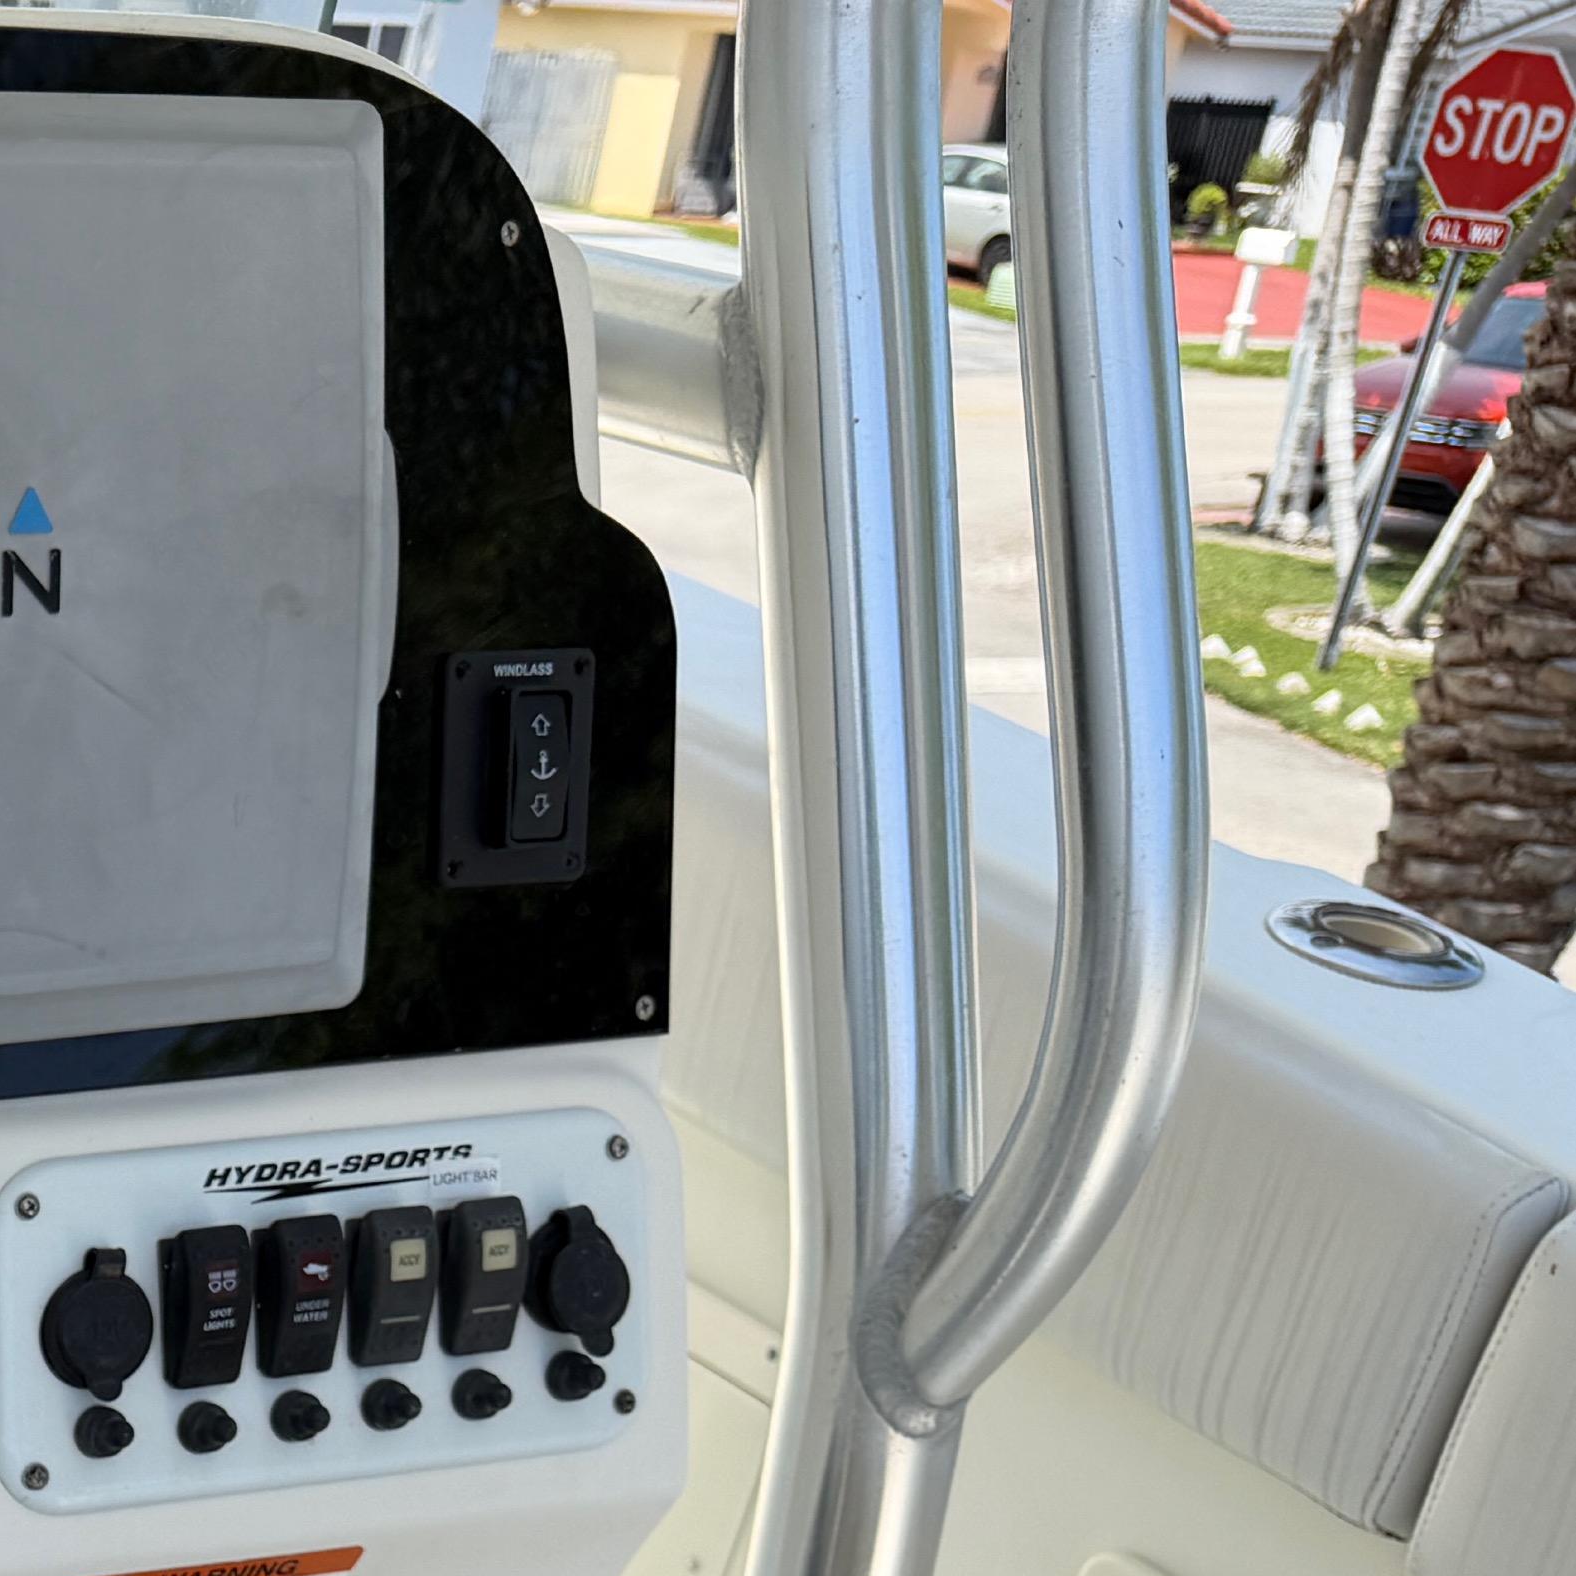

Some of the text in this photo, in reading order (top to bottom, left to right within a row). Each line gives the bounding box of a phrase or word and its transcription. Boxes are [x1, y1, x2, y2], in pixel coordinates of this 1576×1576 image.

[1434, 94, 1565, 167] STOP
[1431, 219, 1504, 246] ALL WAY
[494, 662, 553, 677] WINDLASS
[203, 1144, 473, 1188] HYDRA-SPORTS
[432, 1168, 497, 1187] LIGHT BAR
